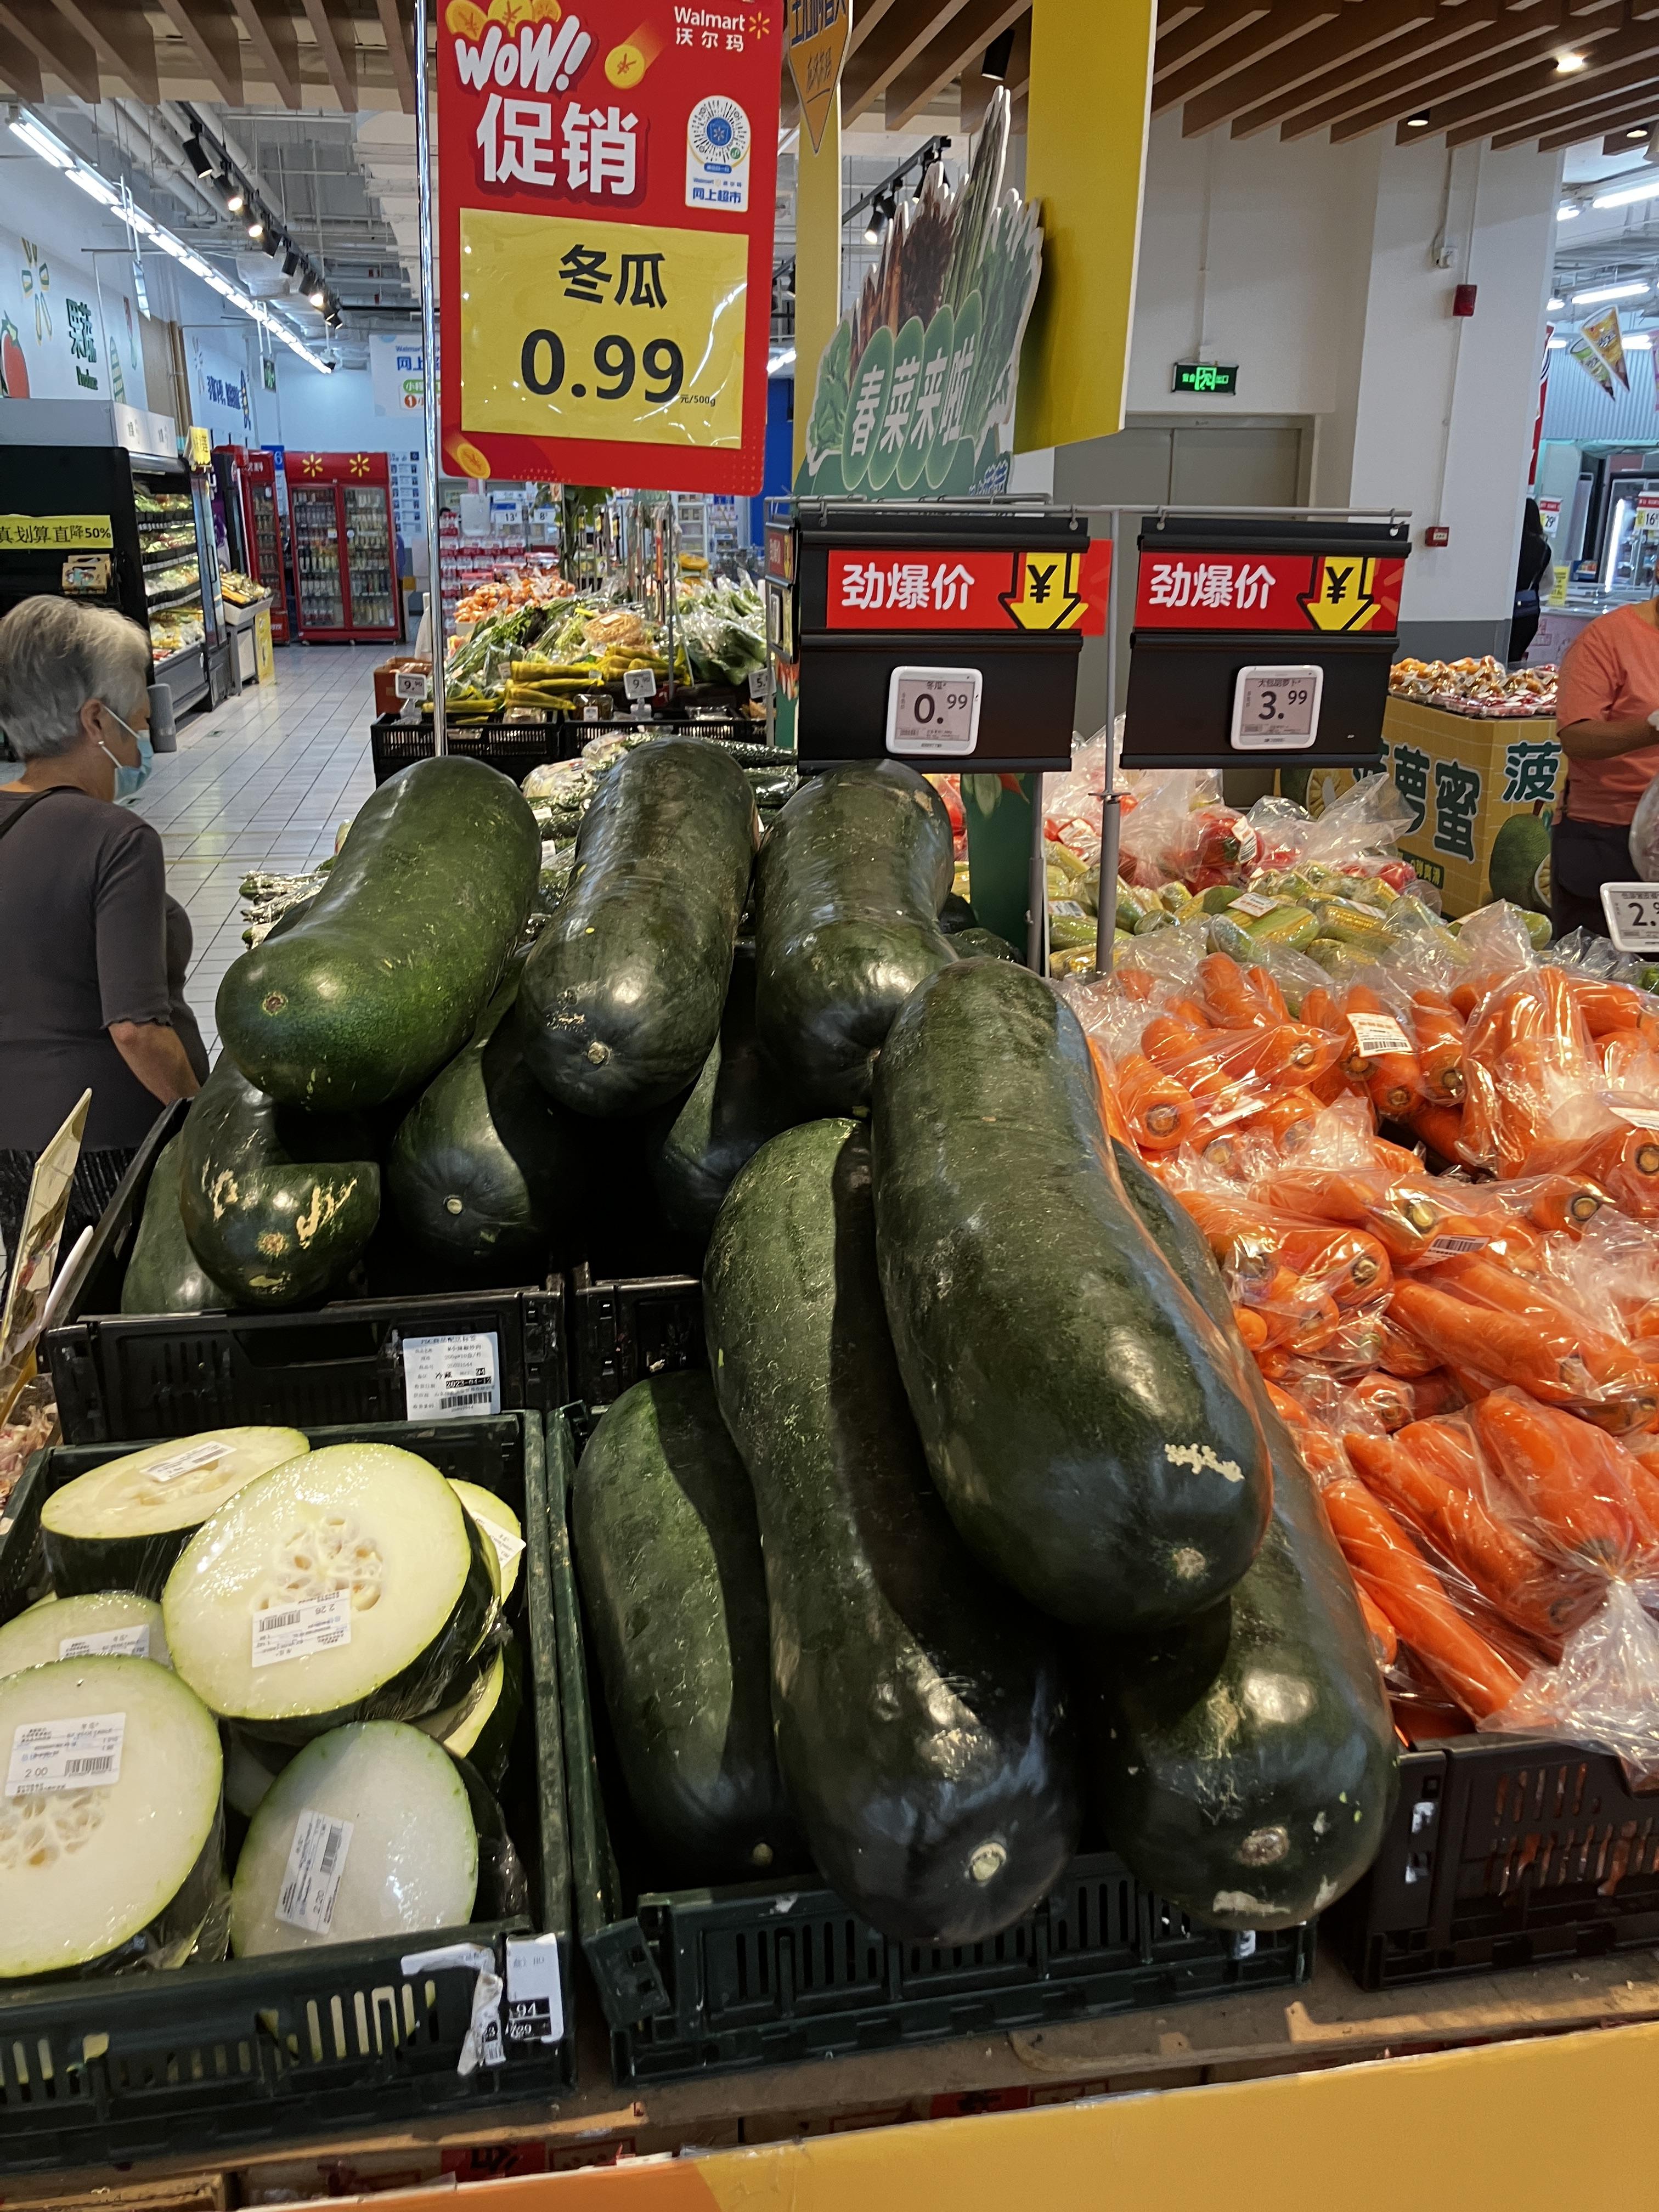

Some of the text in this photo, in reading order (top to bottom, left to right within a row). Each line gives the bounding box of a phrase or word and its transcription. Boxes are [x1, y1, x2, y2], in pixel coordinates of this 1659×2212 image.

[674, 6, 745, 32] Walmart
[676, 27, 744, 52] 沃尔玛
[477, 93, 639, 195] 促销
[693, 187, 741, 204] 网上超市
[558, 244, 668, 309] 冬瓜
[521, 329, 684, 403] 0.99
[851, 334, 975, 456] 春菜来啦
[842, 562, 975, 610] 劲爆价
[1149, 562, 1276, 609] 劲爆价
[1353, 738, 1480, 862] 萝蜜
